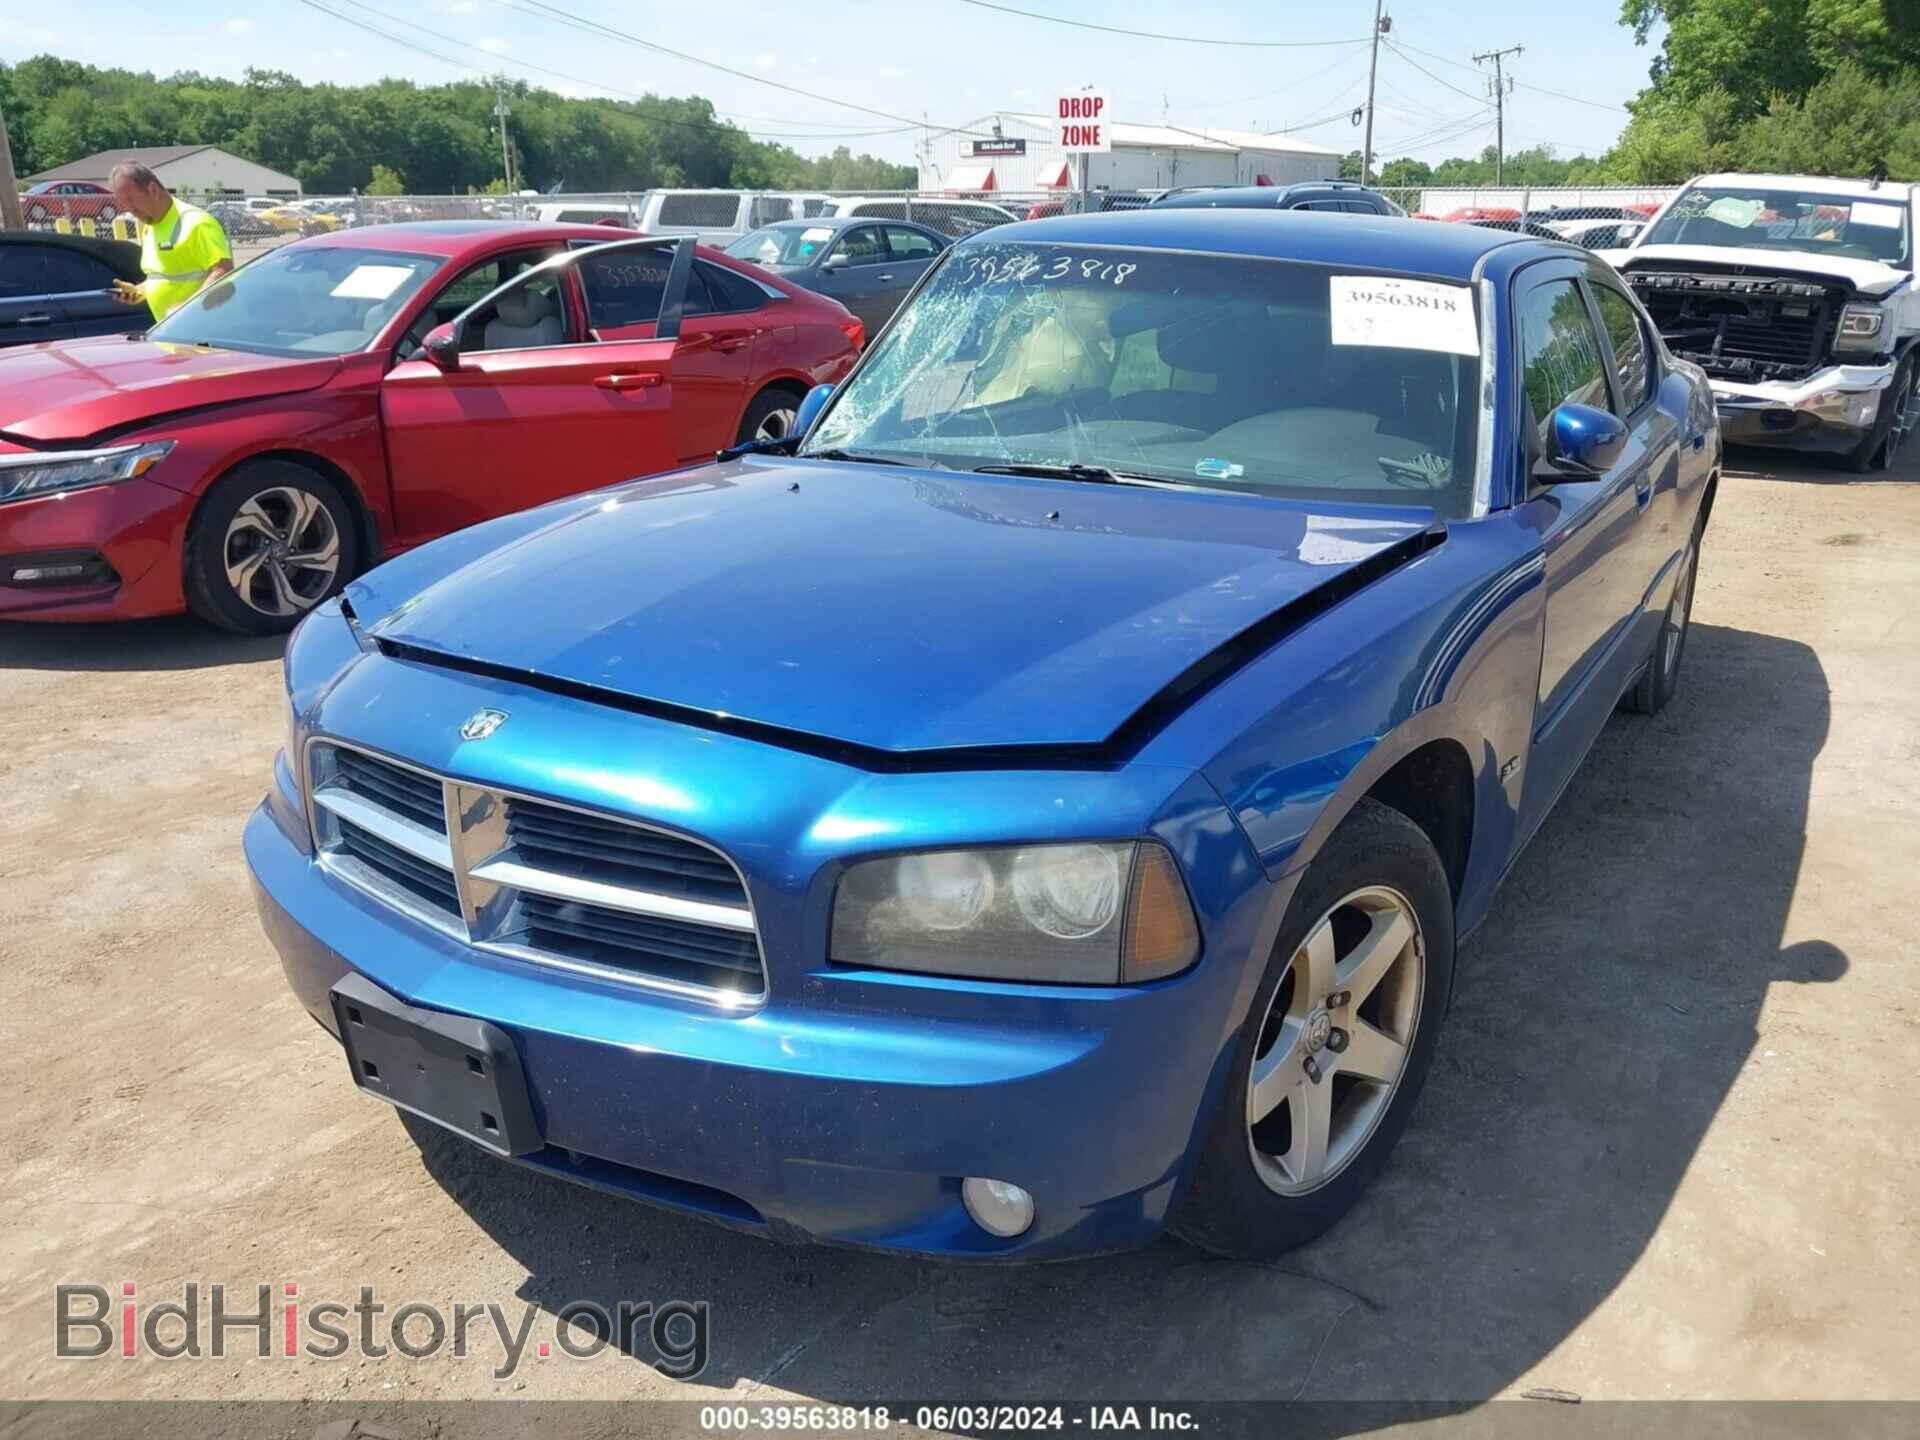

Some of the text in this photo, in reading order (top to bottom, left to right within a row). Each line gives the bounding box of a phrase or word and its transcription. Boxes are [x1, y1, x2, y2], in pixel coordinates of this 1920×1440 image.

[1059, 97, 1104, 119] DROP
[1061, 125, 1101, 147] ZONE
[1345, 290, 1457, 313] 39563818
